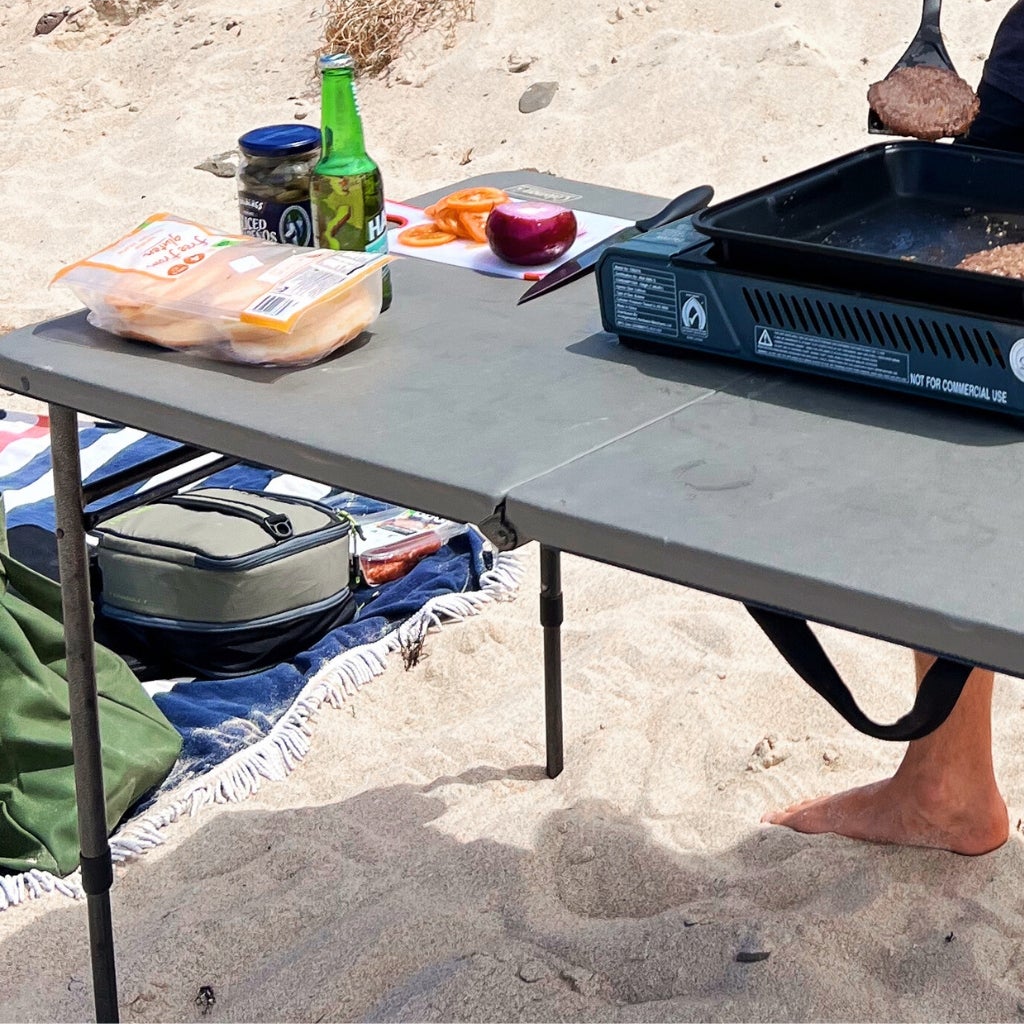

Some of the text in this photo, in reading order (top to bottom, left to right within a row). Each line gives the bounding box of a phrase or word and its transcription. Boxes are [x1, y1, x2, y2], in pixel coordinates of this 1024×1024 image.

[142, 233, 182, 258] gluten
[910, 373, 1008, 404] NOT FOR COMMERCIAL USE
